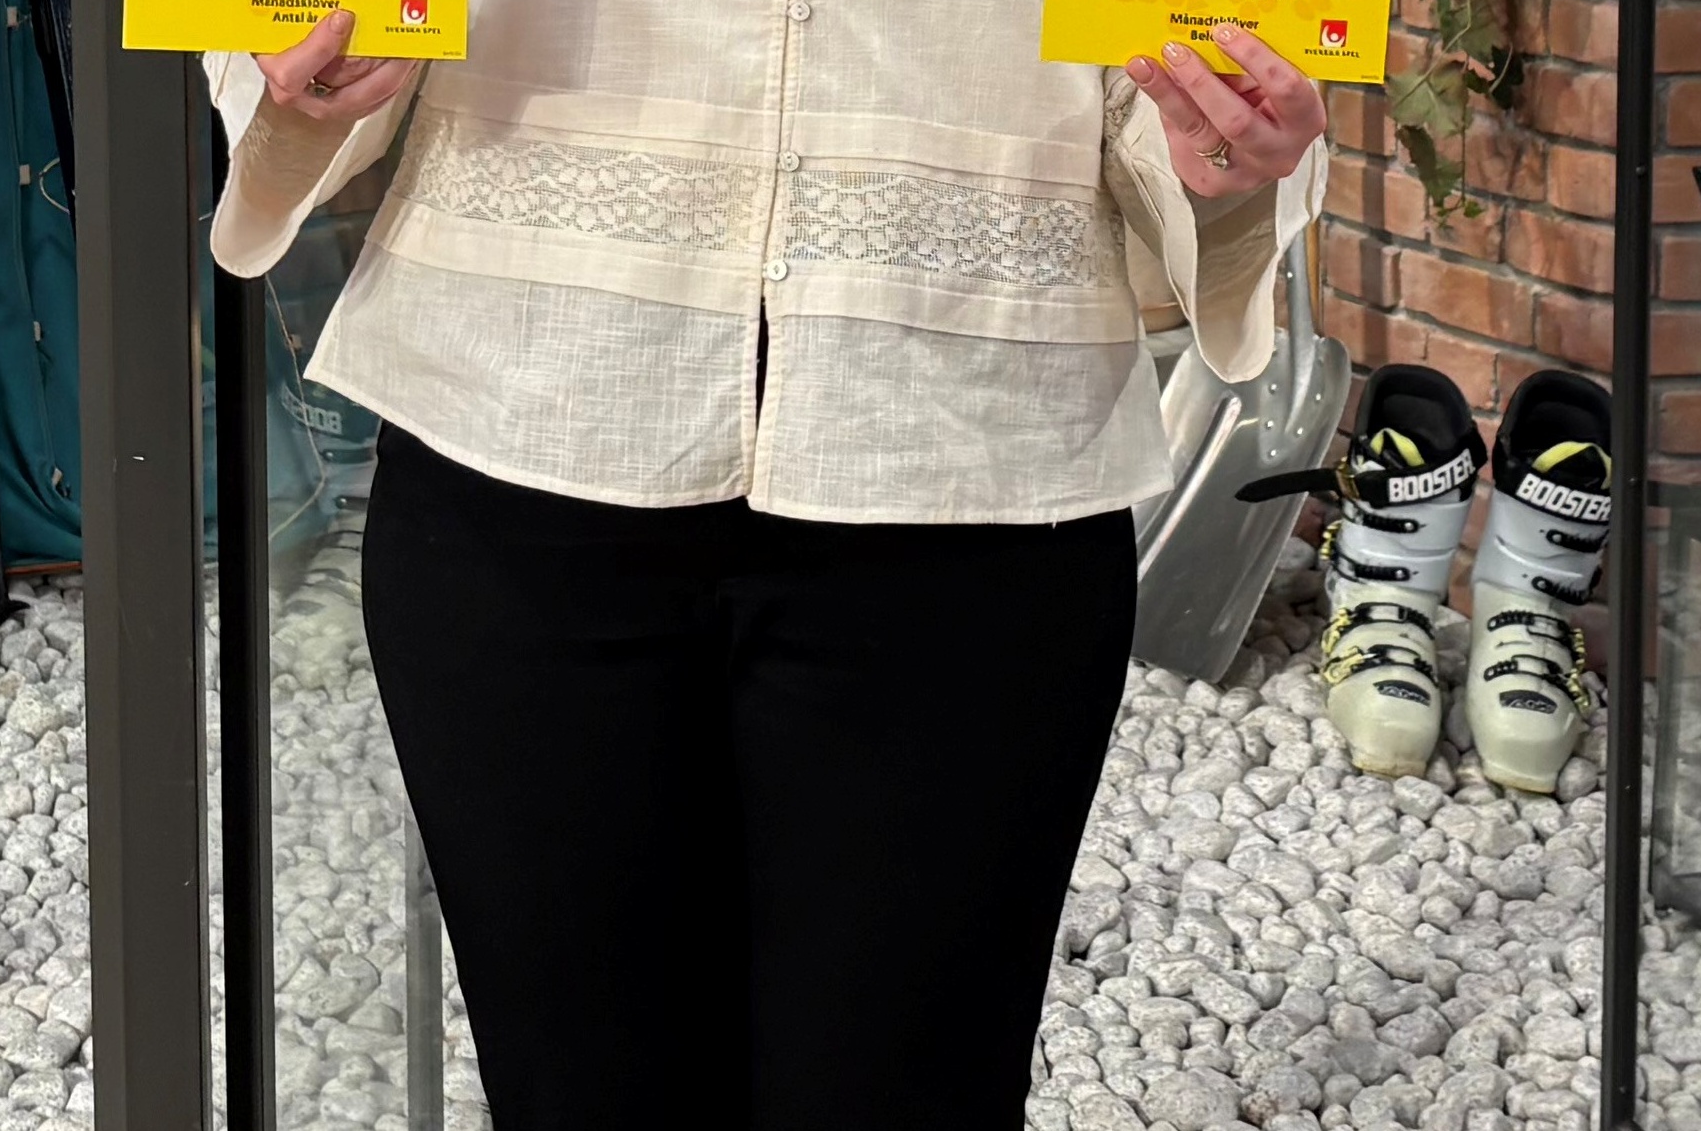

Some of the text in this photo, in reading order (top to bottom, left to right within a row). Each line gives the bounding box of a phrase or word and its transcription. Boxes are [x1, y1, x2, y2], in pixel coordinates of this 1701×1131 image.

[273, 12, 318, 23] Antal år
[1389, 448, 1476, 502] BOOSTER
[1515, 472, 1611, 521] BOOSTER
